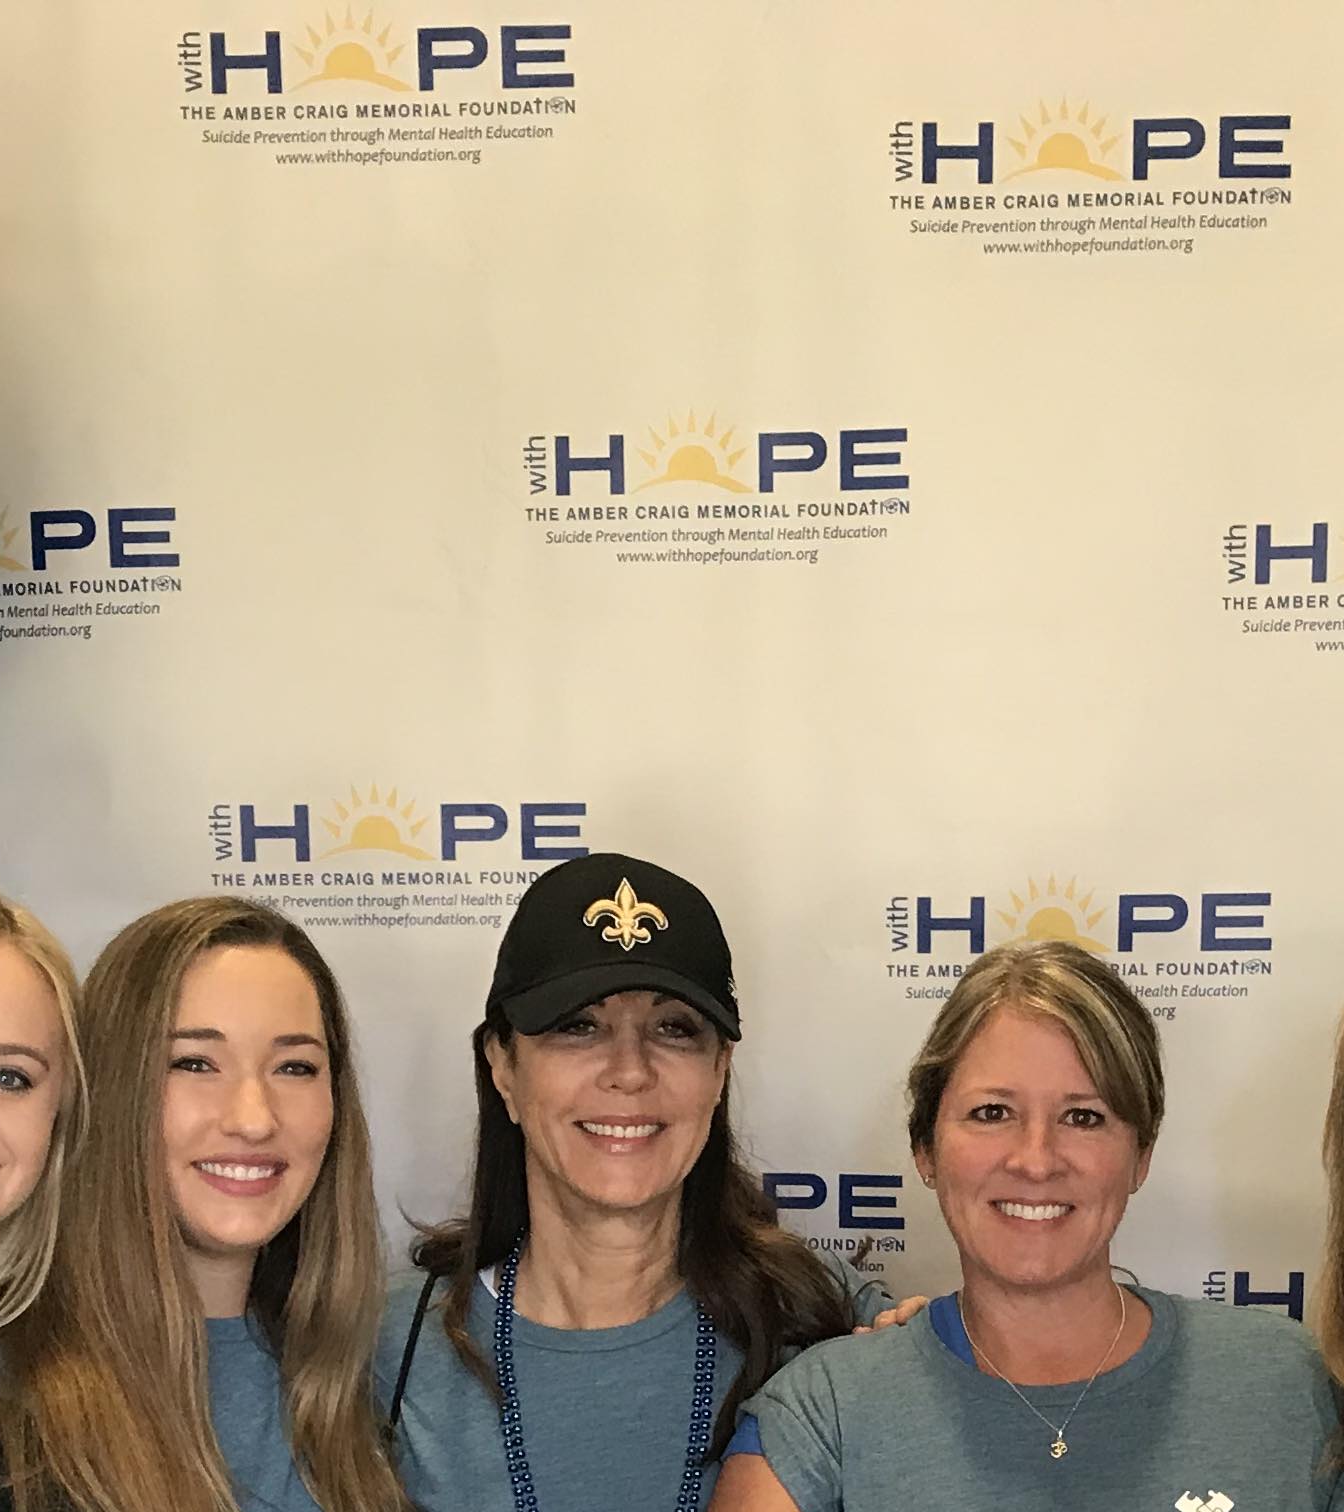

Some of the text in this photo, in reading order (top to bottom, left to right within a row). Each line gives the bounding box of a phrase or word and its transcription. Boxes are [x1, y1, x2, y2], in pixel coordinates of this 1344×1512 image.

[177, 32, 202, 92] with
[180, 97, 575, 120] THE AMBER CRAIG MEMORIAL FOUNDATION
[202, 125, 553, 145] Suicide Prevention through Mental Health Education
[276, 148, 481, 166] www.withhopefoundation.org
[889, 122, 913, 182] with
[890, 187, 1291, 210] THE AMBER CRAIG MEMORIAL FOUNDATION
[910, 214, 1267, 235] Suicide Prevention through Mental Health Education
[984, 237, 1194, 255] www.withhopefoundation.org
[523, 436, 547, 495] with
[525, 498, 910, 521] THE AMBER CRAIG MEMORIAL FOUNDATION
[546, 525, 887, 545] Suicide Prevention through Mental Health Education
[616, 548, 818, 565] www.withhopefoundation.org
[1222, 525, 1247, 584] with
[70, 576, 181, 594] FOUNDATION
[7, 602, 160, 618] Mental Health Education
[1222, 597, 1257, 610] THE
[1264, 595, 1329, 610] AMBER
[1242, 619, 1291, 633] Suicide
[208, 805, 232, 860] with
[211, 872, 472, 886] THE AMBER CRAIG MEMORIAL
[283, 895, 354, 908] Prevention
[357, 894, 409, 910] through
[412, 894, 458, 906] Mental
[461, 893, 502, 906] Health
[304, 913, 501, 929] www.withhopefoundation.org
[886, 897, 908, 952] with
[886, 959, 1271, 977] THE FOUNDATION
[906, 984, 1248, 999] Suicide Health Education
